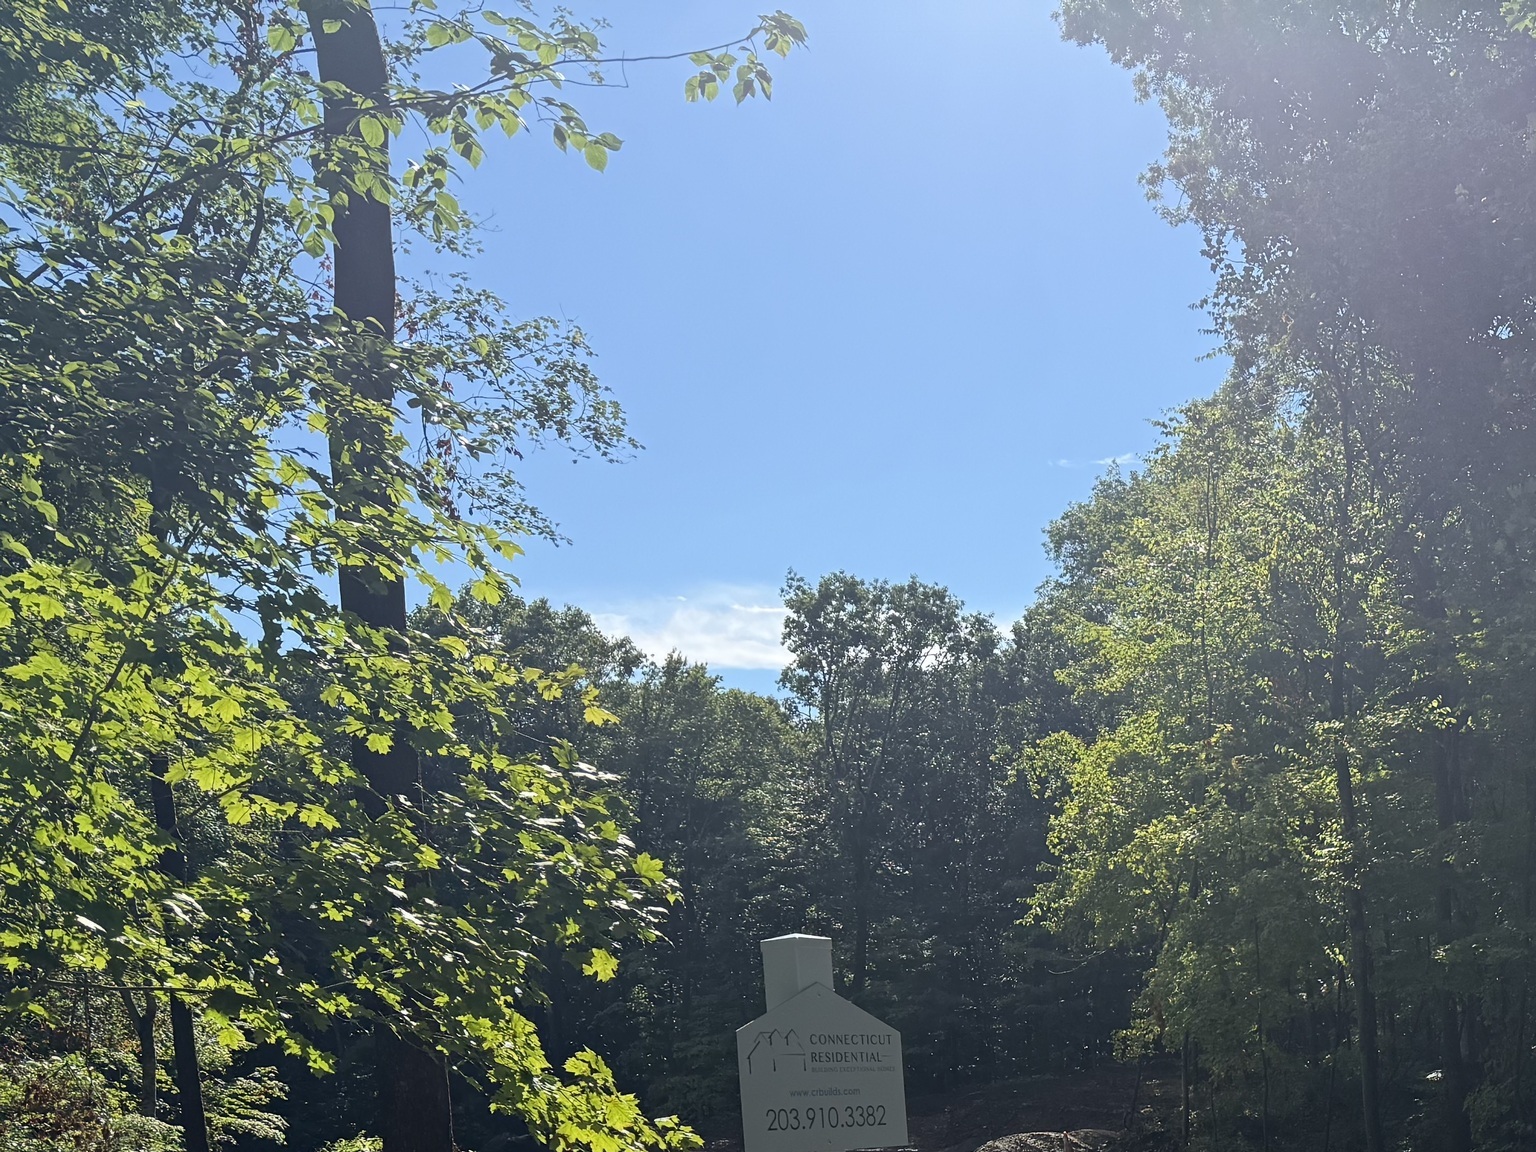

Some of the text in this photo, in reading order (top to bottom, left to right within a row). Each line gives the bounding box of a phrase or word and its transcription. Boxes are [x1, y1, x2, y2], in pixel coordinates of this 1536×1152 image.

[809, 1033, 892, 1046] CONNECTICUT
[811, 1051, 882, 1063] RESIDENTIAL
[789, 1087, 861, 1097] www.crbuilds.com
[766, 1105, 887, 1131] 203.910.3382
